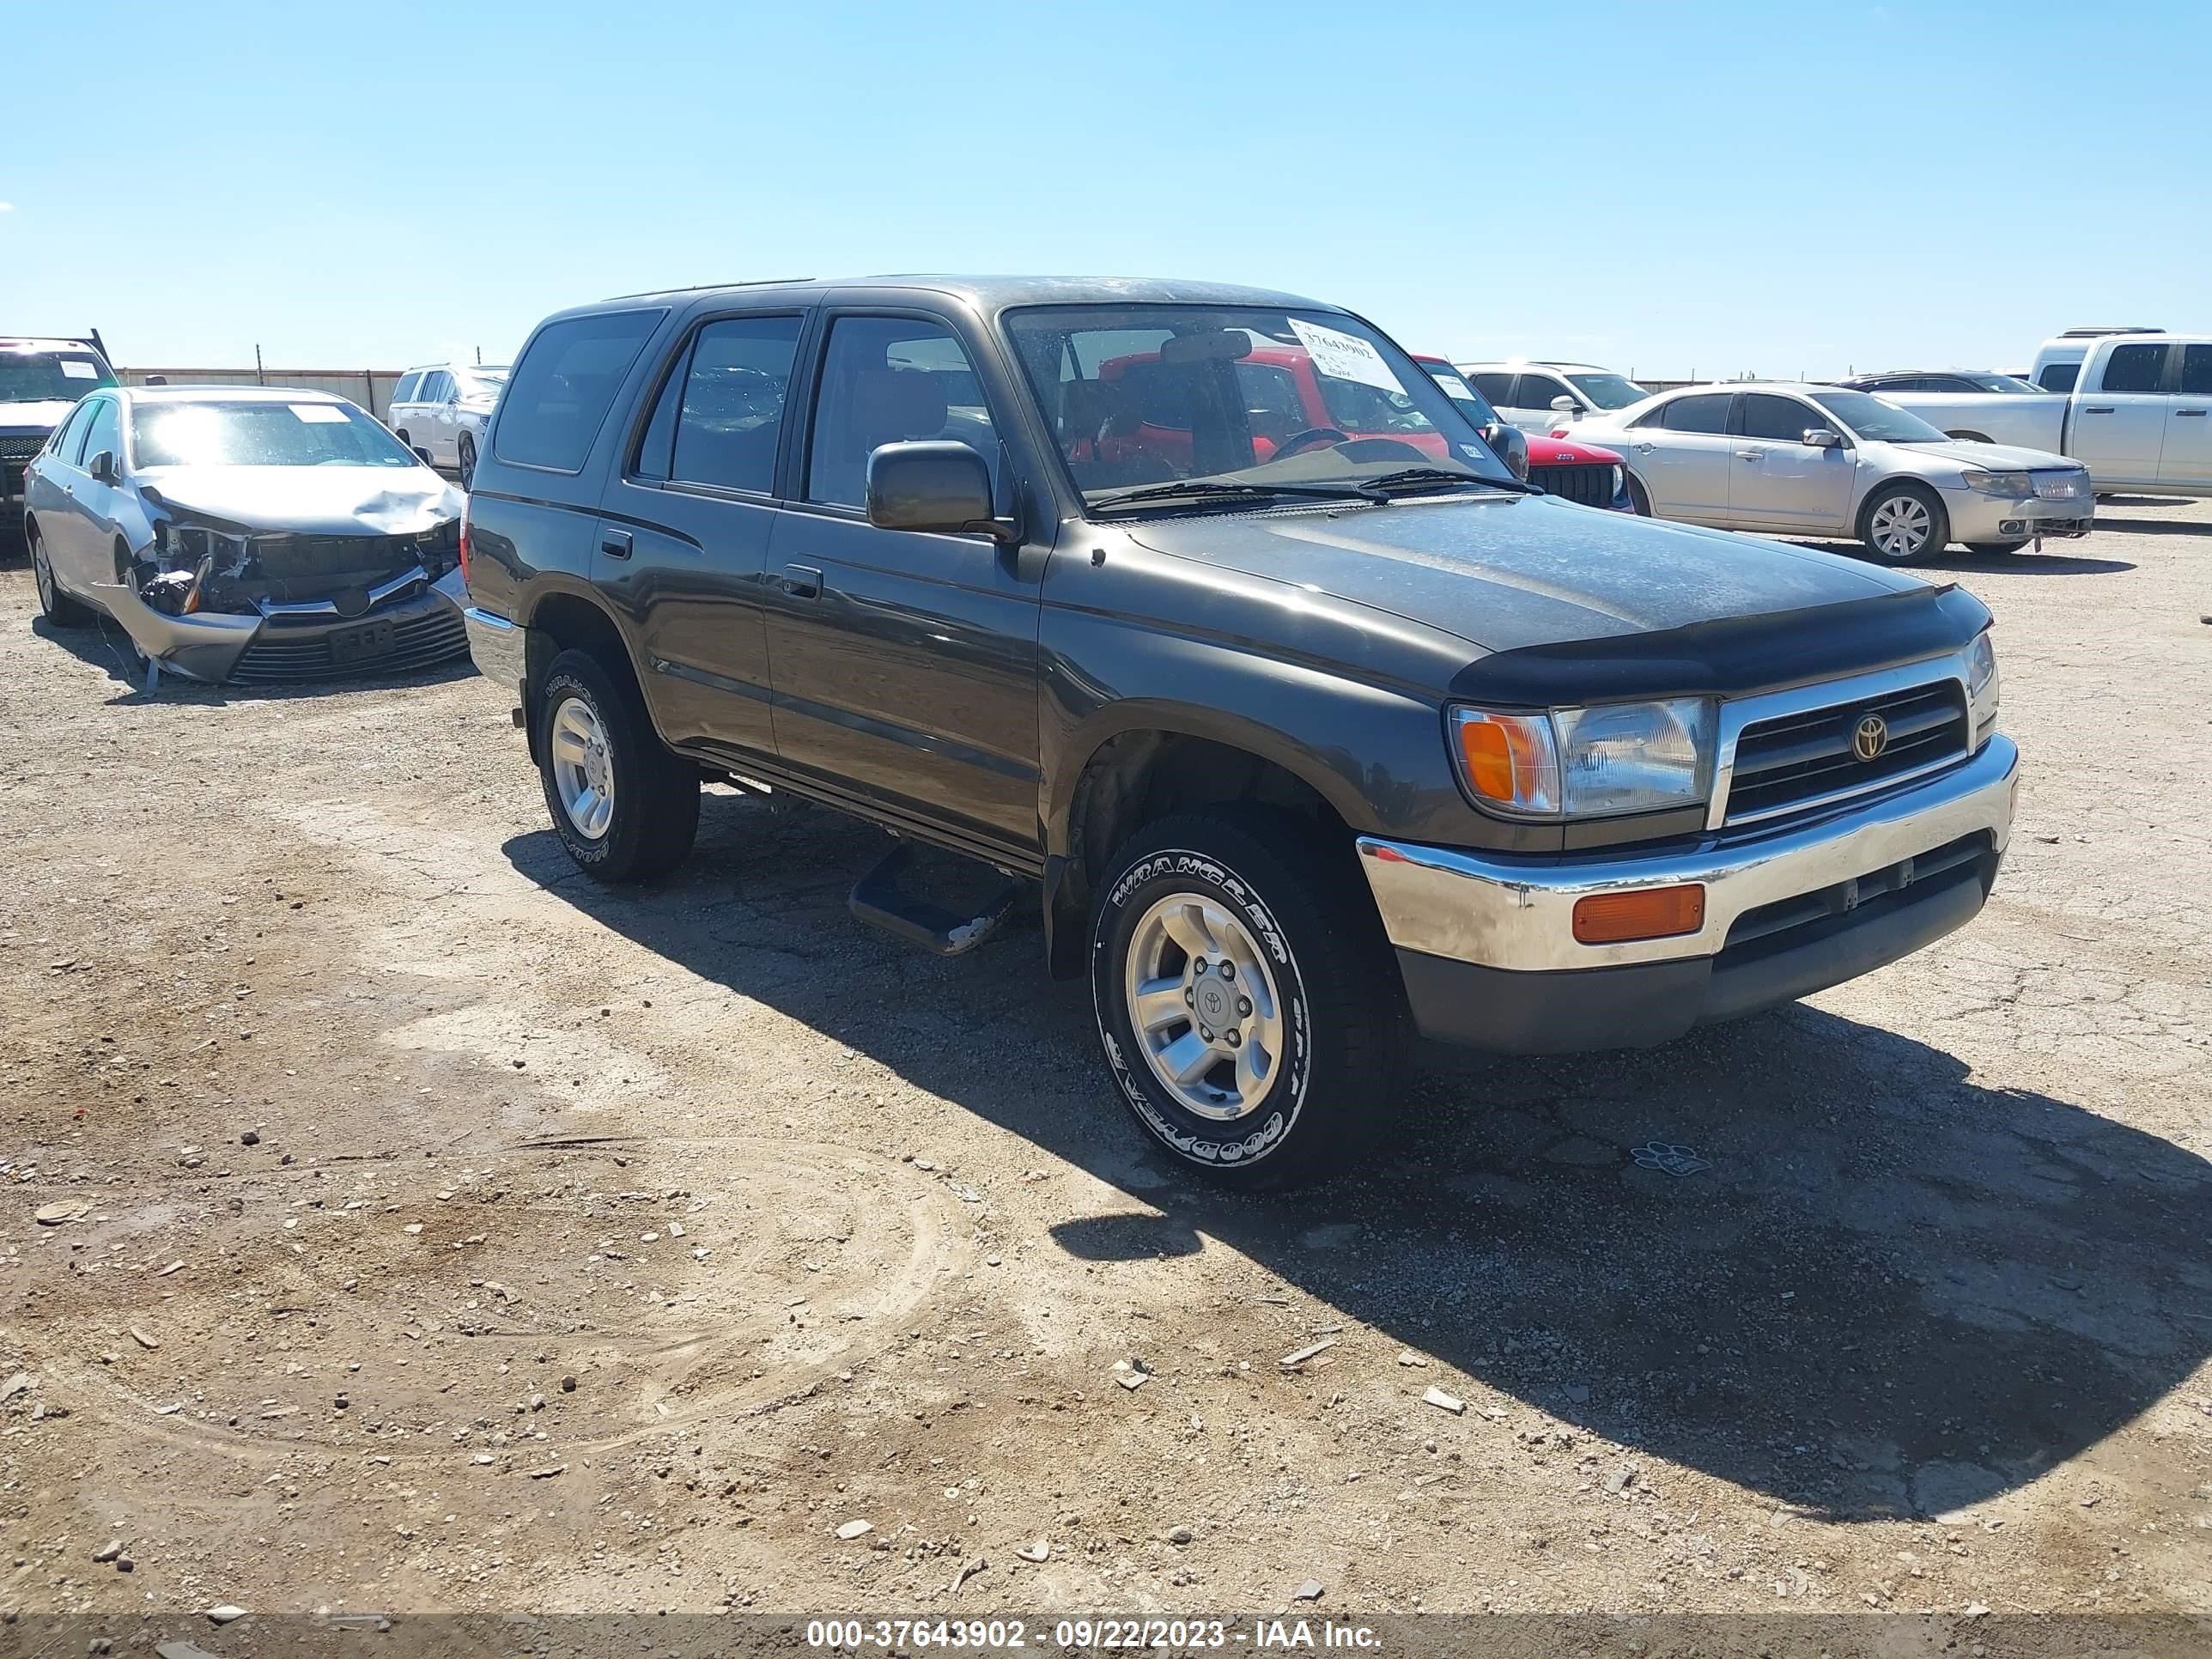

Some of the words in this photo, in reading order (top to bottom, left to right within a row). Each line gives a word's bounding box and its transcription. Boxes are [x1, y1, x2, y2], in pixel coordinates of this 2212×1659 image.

[1304, 331, 1374, 360] 37643902
[1111, 856, 1287, 965] WRANGLER
[1105, 1030, 1284, 1162] GOODYEAR
